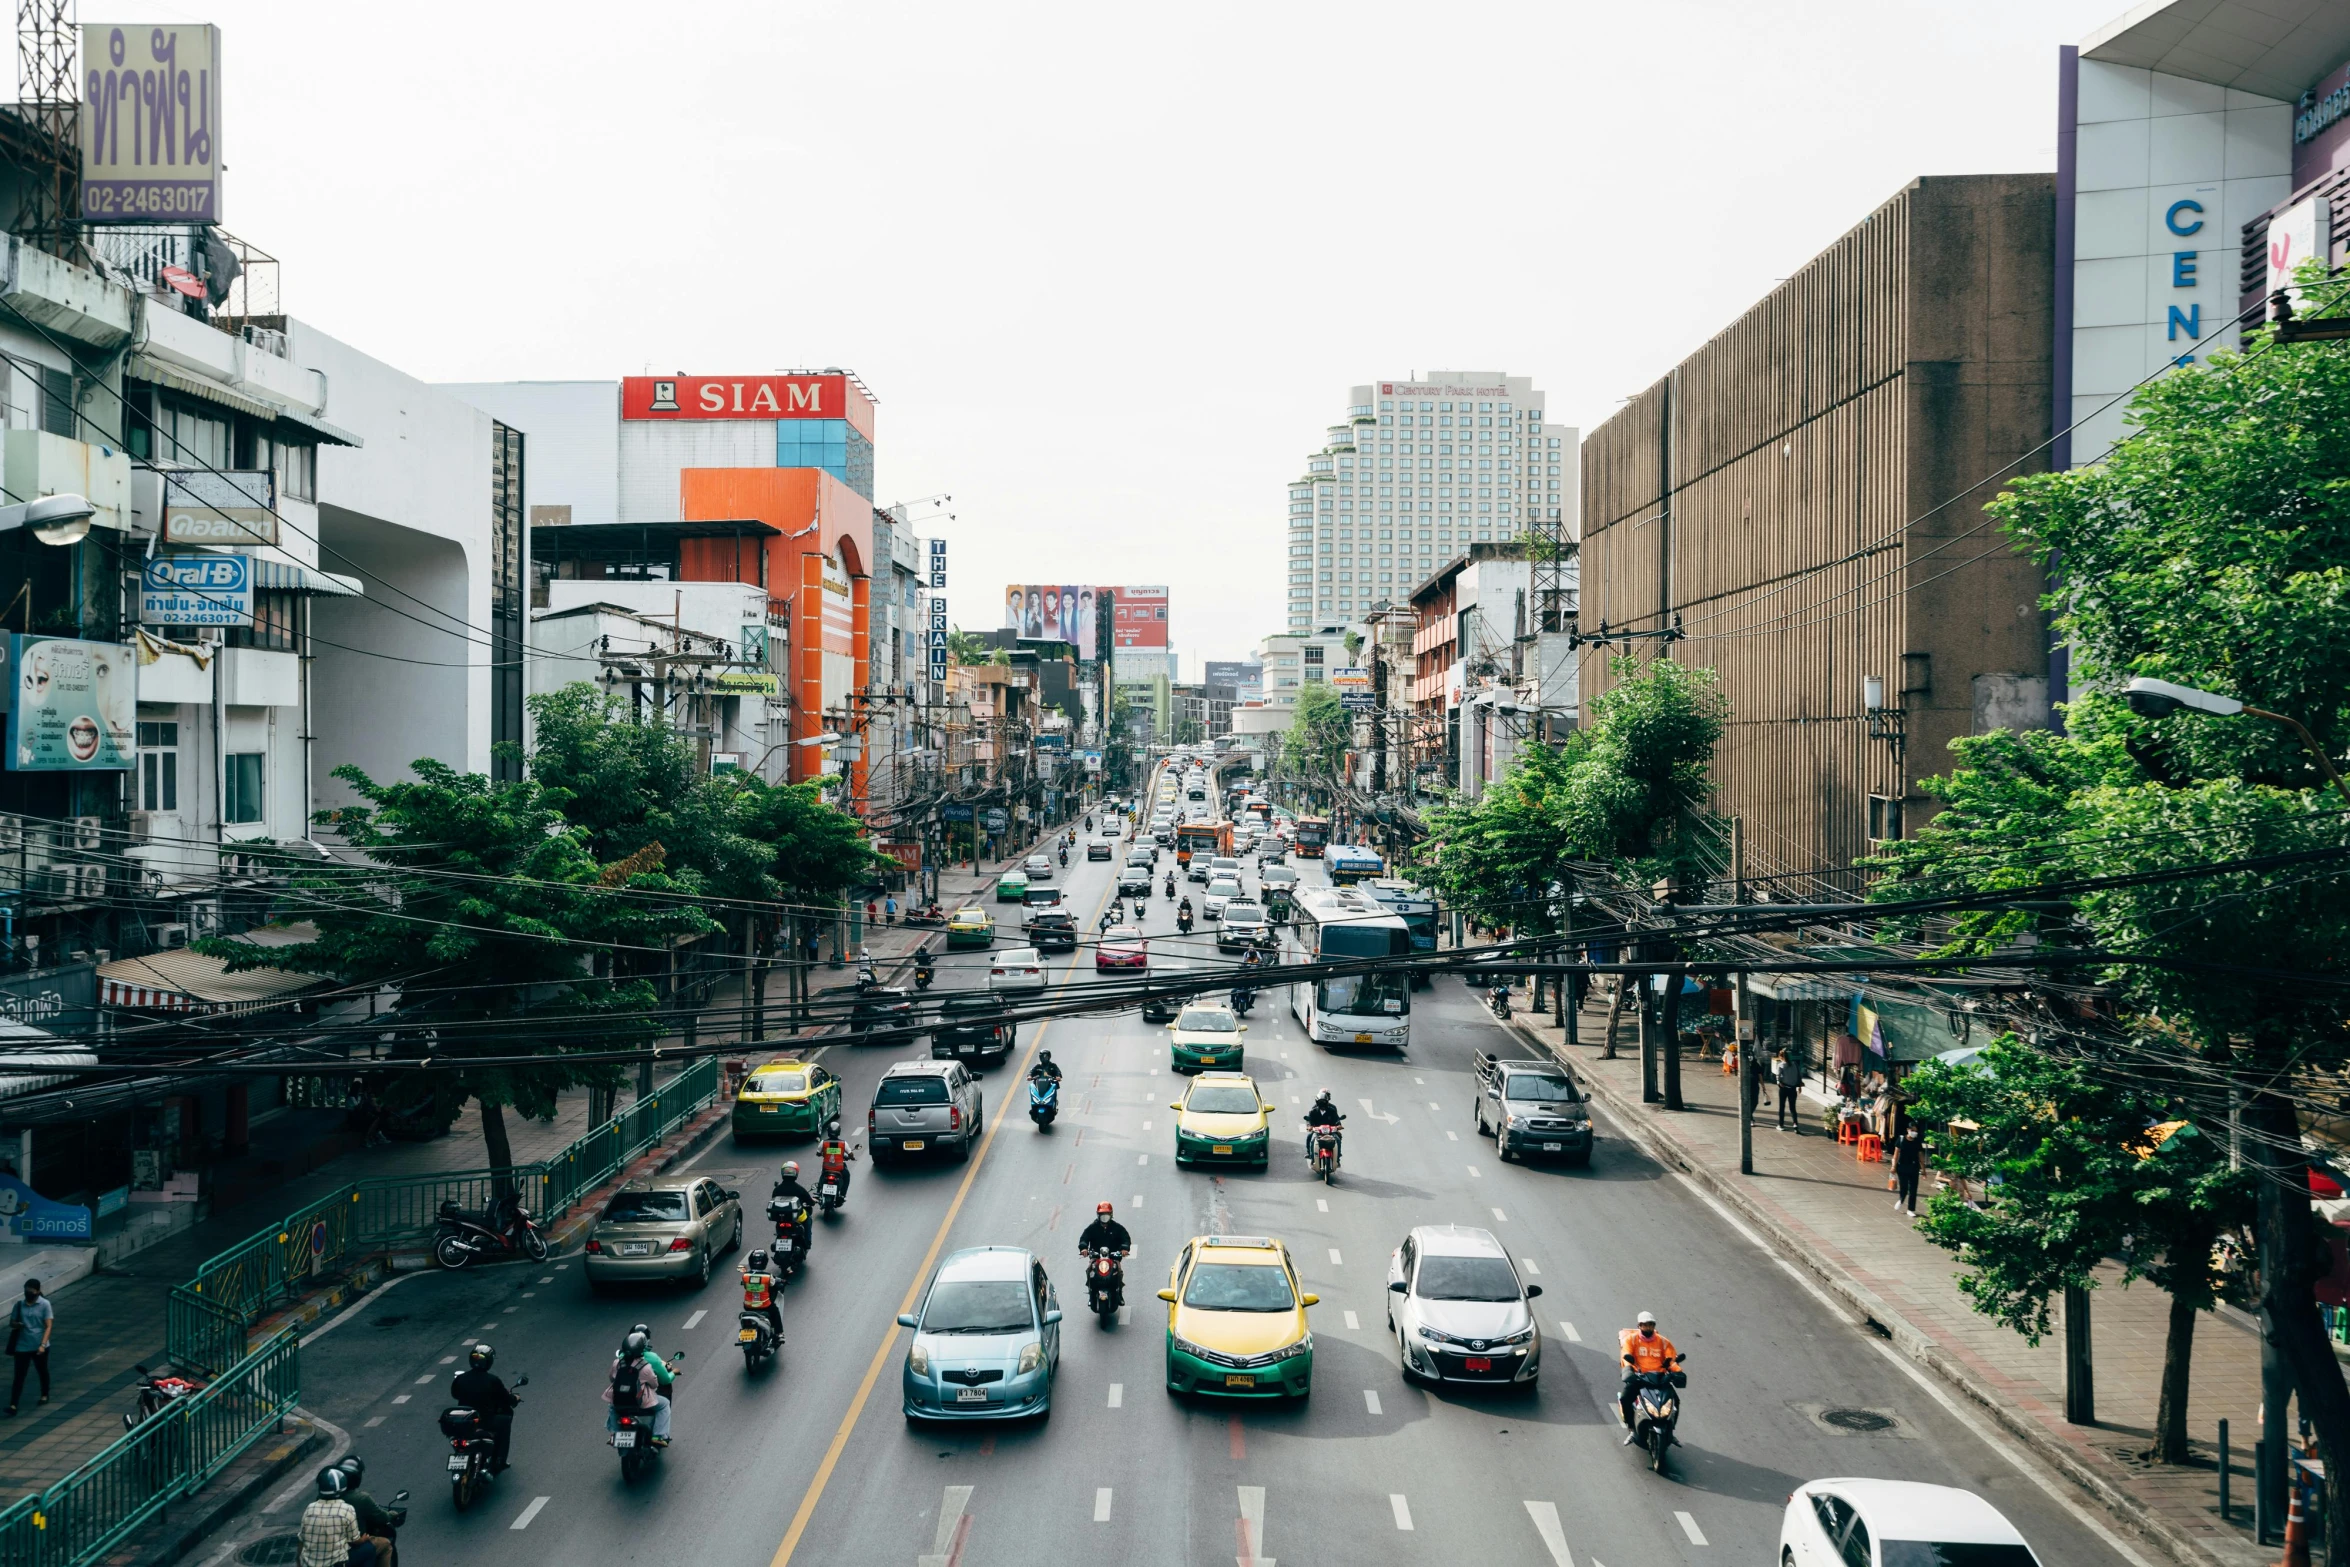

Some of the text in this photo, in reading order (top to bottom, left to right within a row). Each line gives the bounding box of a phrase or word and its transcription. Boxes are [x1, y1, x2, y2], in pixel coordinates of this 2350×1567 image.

[87, 27, 211, 166] ทำฟัน
[88, 186, 210, 213] 02-2463017
[699, 382, 822, 413] SIAM
[1476, 387, 1509, 397] HOTEL
[169, 514, 272, 537] คอลเกต
[152, 562, 233, 585] Oral-B
[163, 613, 239, 623] 02-2463017
[933, 541, 944, 680] THE BRAIN
[36, 1214, 87, 1232] วิคทอรี่
[970, 1389, 985, 1397] 7804
